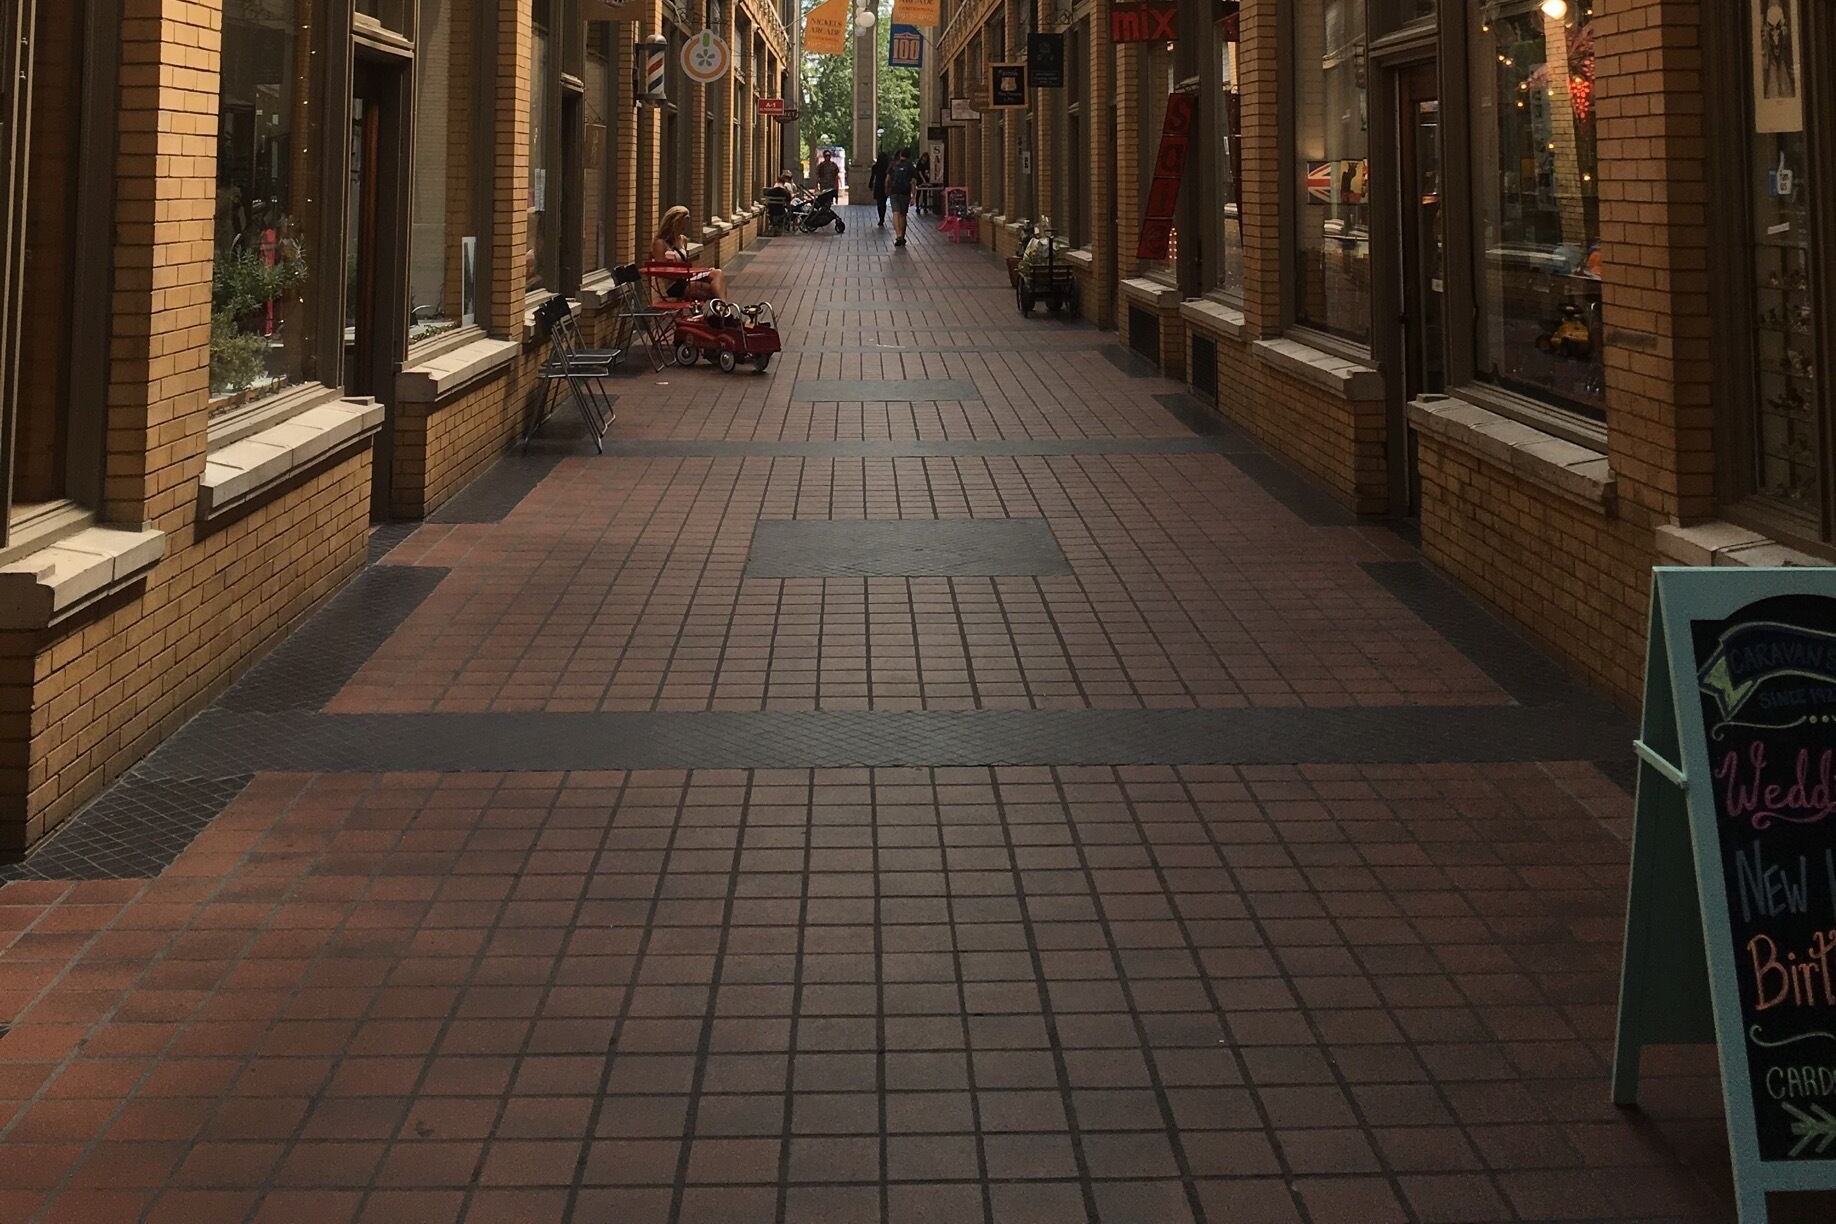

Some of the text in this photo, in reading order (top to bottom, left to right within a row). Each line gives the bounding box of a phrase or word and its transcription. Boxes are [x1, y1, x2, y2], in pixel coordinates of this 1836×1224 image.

[1111, 4, 1178, 42] mix
[893, 39, 920, 60] 100
[1729, 640, 1821, 675] CARAVAN
[1736, 840, 1807, 923] NEW
